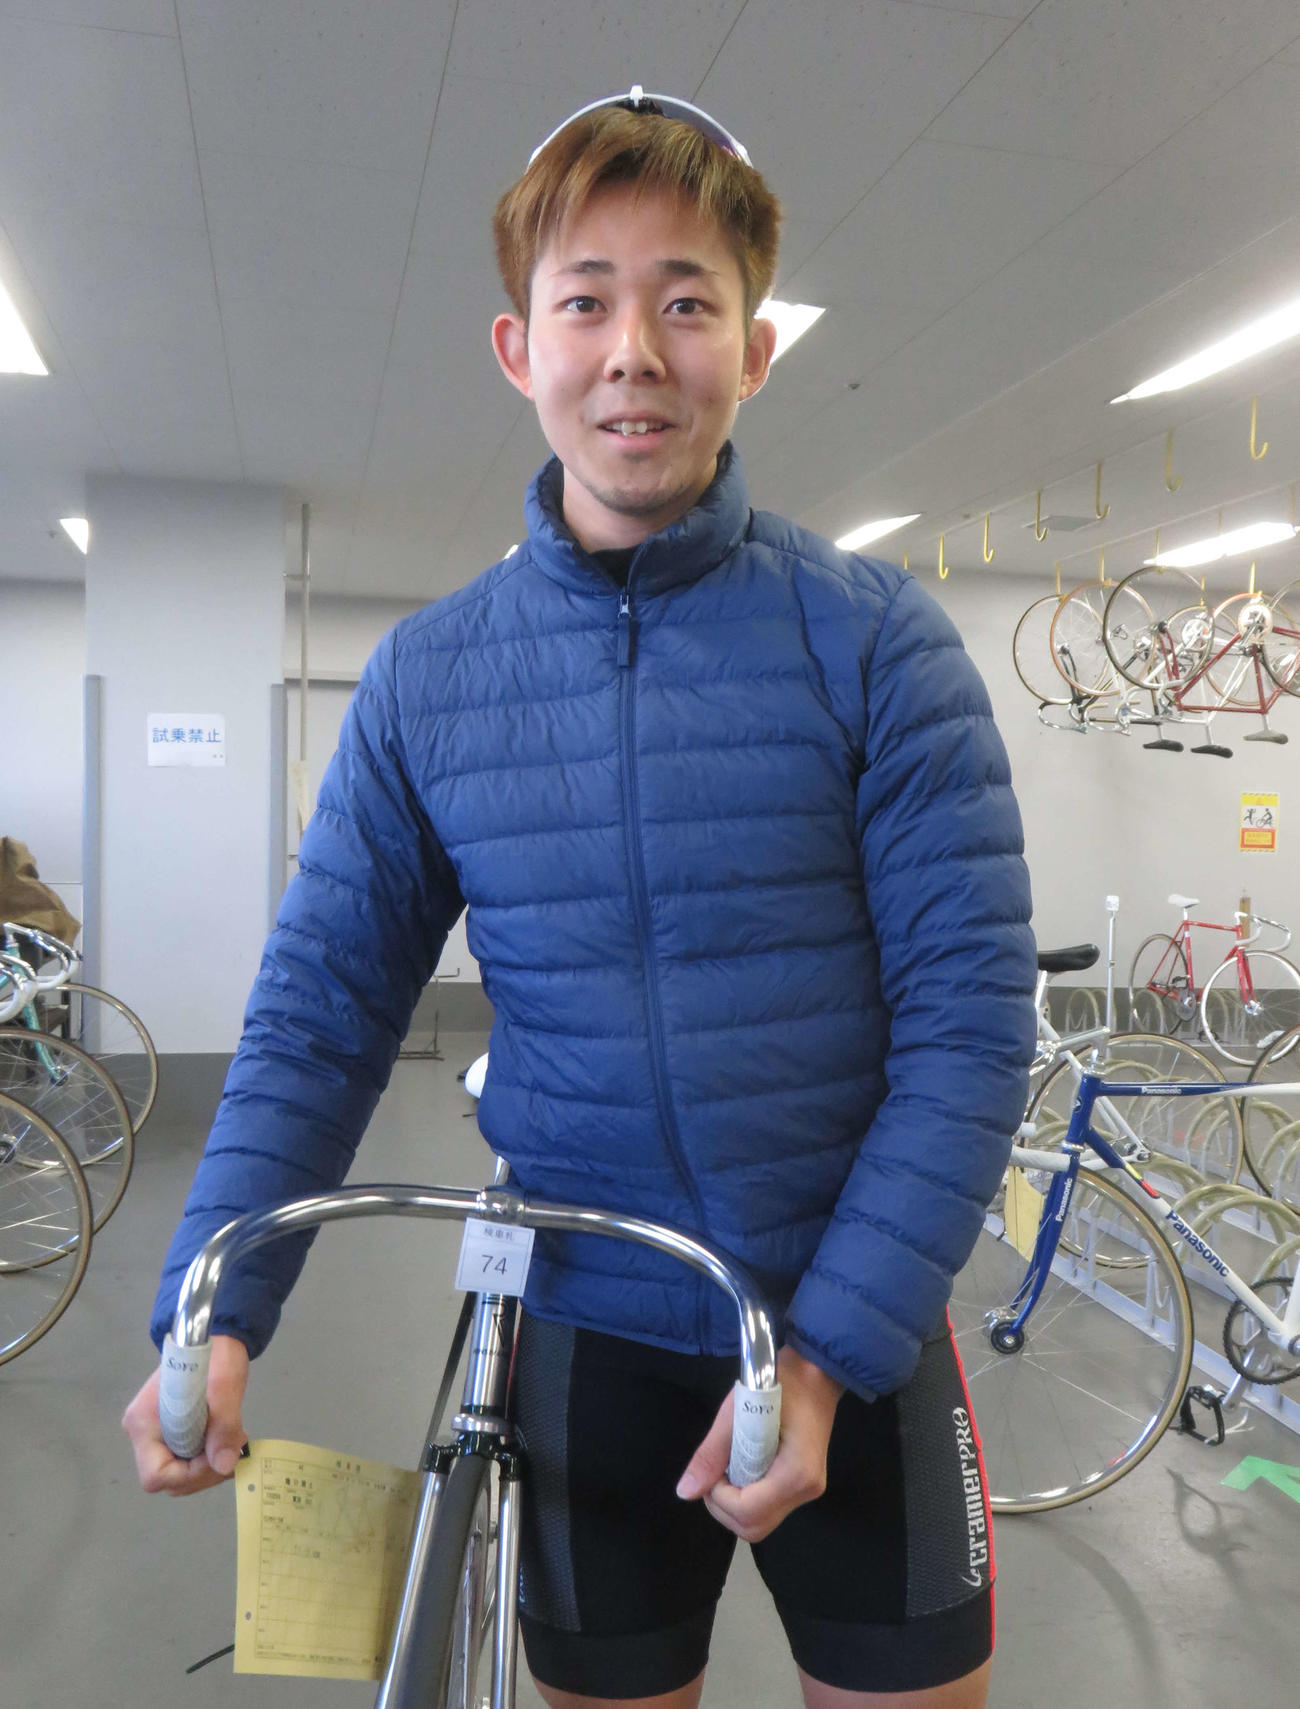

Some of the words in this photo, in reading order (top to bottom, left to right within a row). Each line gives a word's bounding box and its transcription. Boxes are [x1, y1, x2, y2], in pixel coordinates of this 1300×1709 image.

[152, 727, 222, 743] 試乗禁止
[1055, 1177, 1072, 1222] Panasonic
[1165, 1210, 1230, 1277] Panasonic
[481, 1254, 508, 1275] 74
